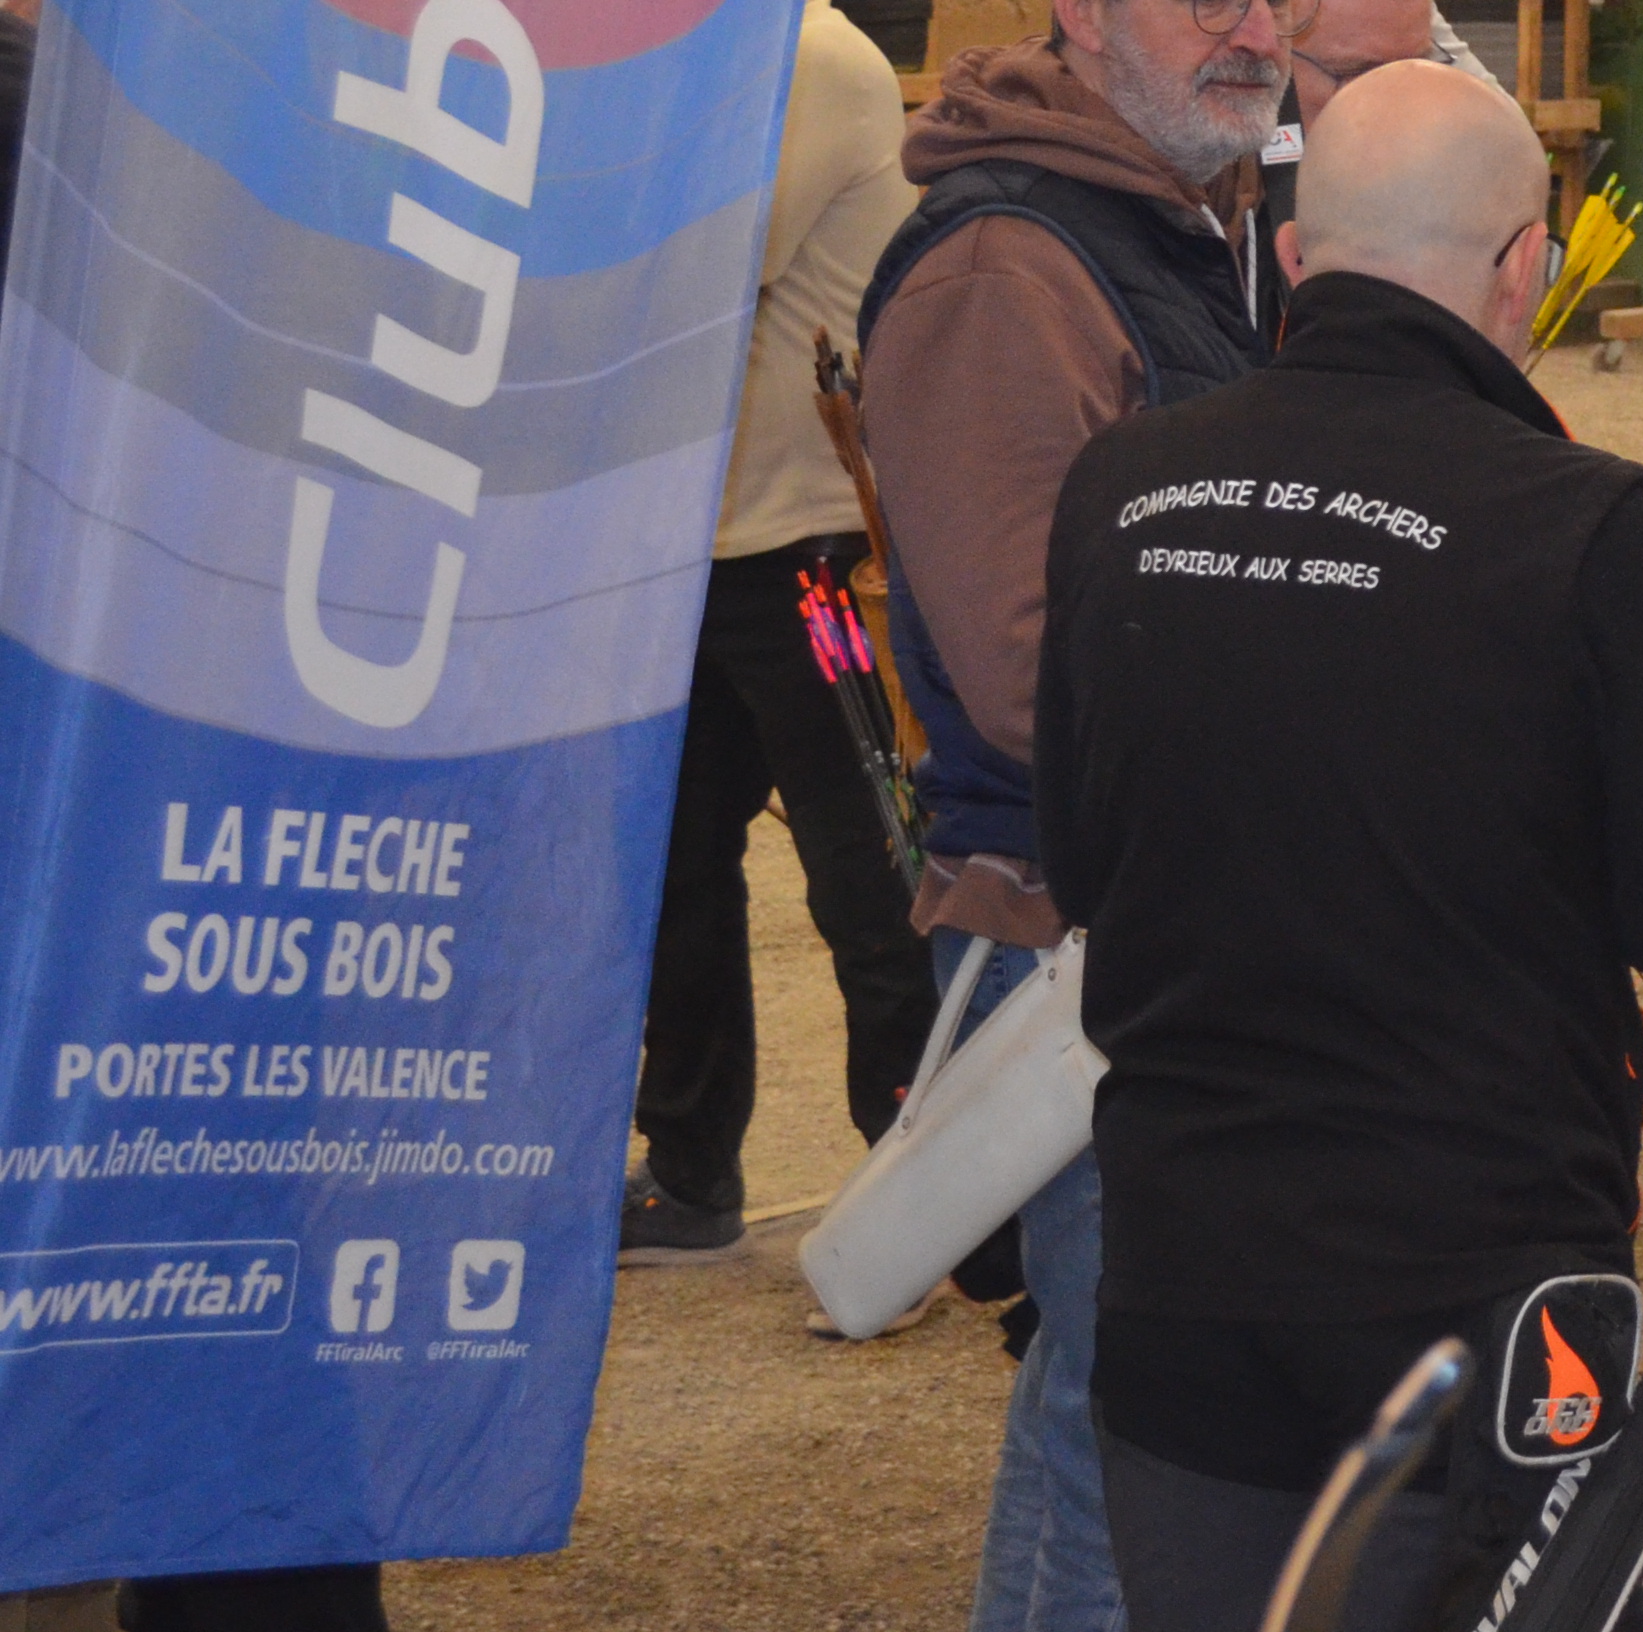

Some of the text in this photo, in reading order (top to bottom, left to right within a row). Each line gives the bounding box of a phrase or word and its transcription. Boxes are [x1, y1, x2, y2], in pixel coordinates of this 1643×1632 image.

[1118, 479, 1448, 550] COMPAGNIE DES ARCHERS
[1138, 547, 1381, 590] D'EYRIEUX AUX SERRES
[160, 802, 471, 898] LA FLECHE
[142, 912, 456, 1000] SOUS BOIS
[55, 1043, 491, 1101] PORTES LES VALENCE
[1472, 1457, 1592, 1632] VALON
